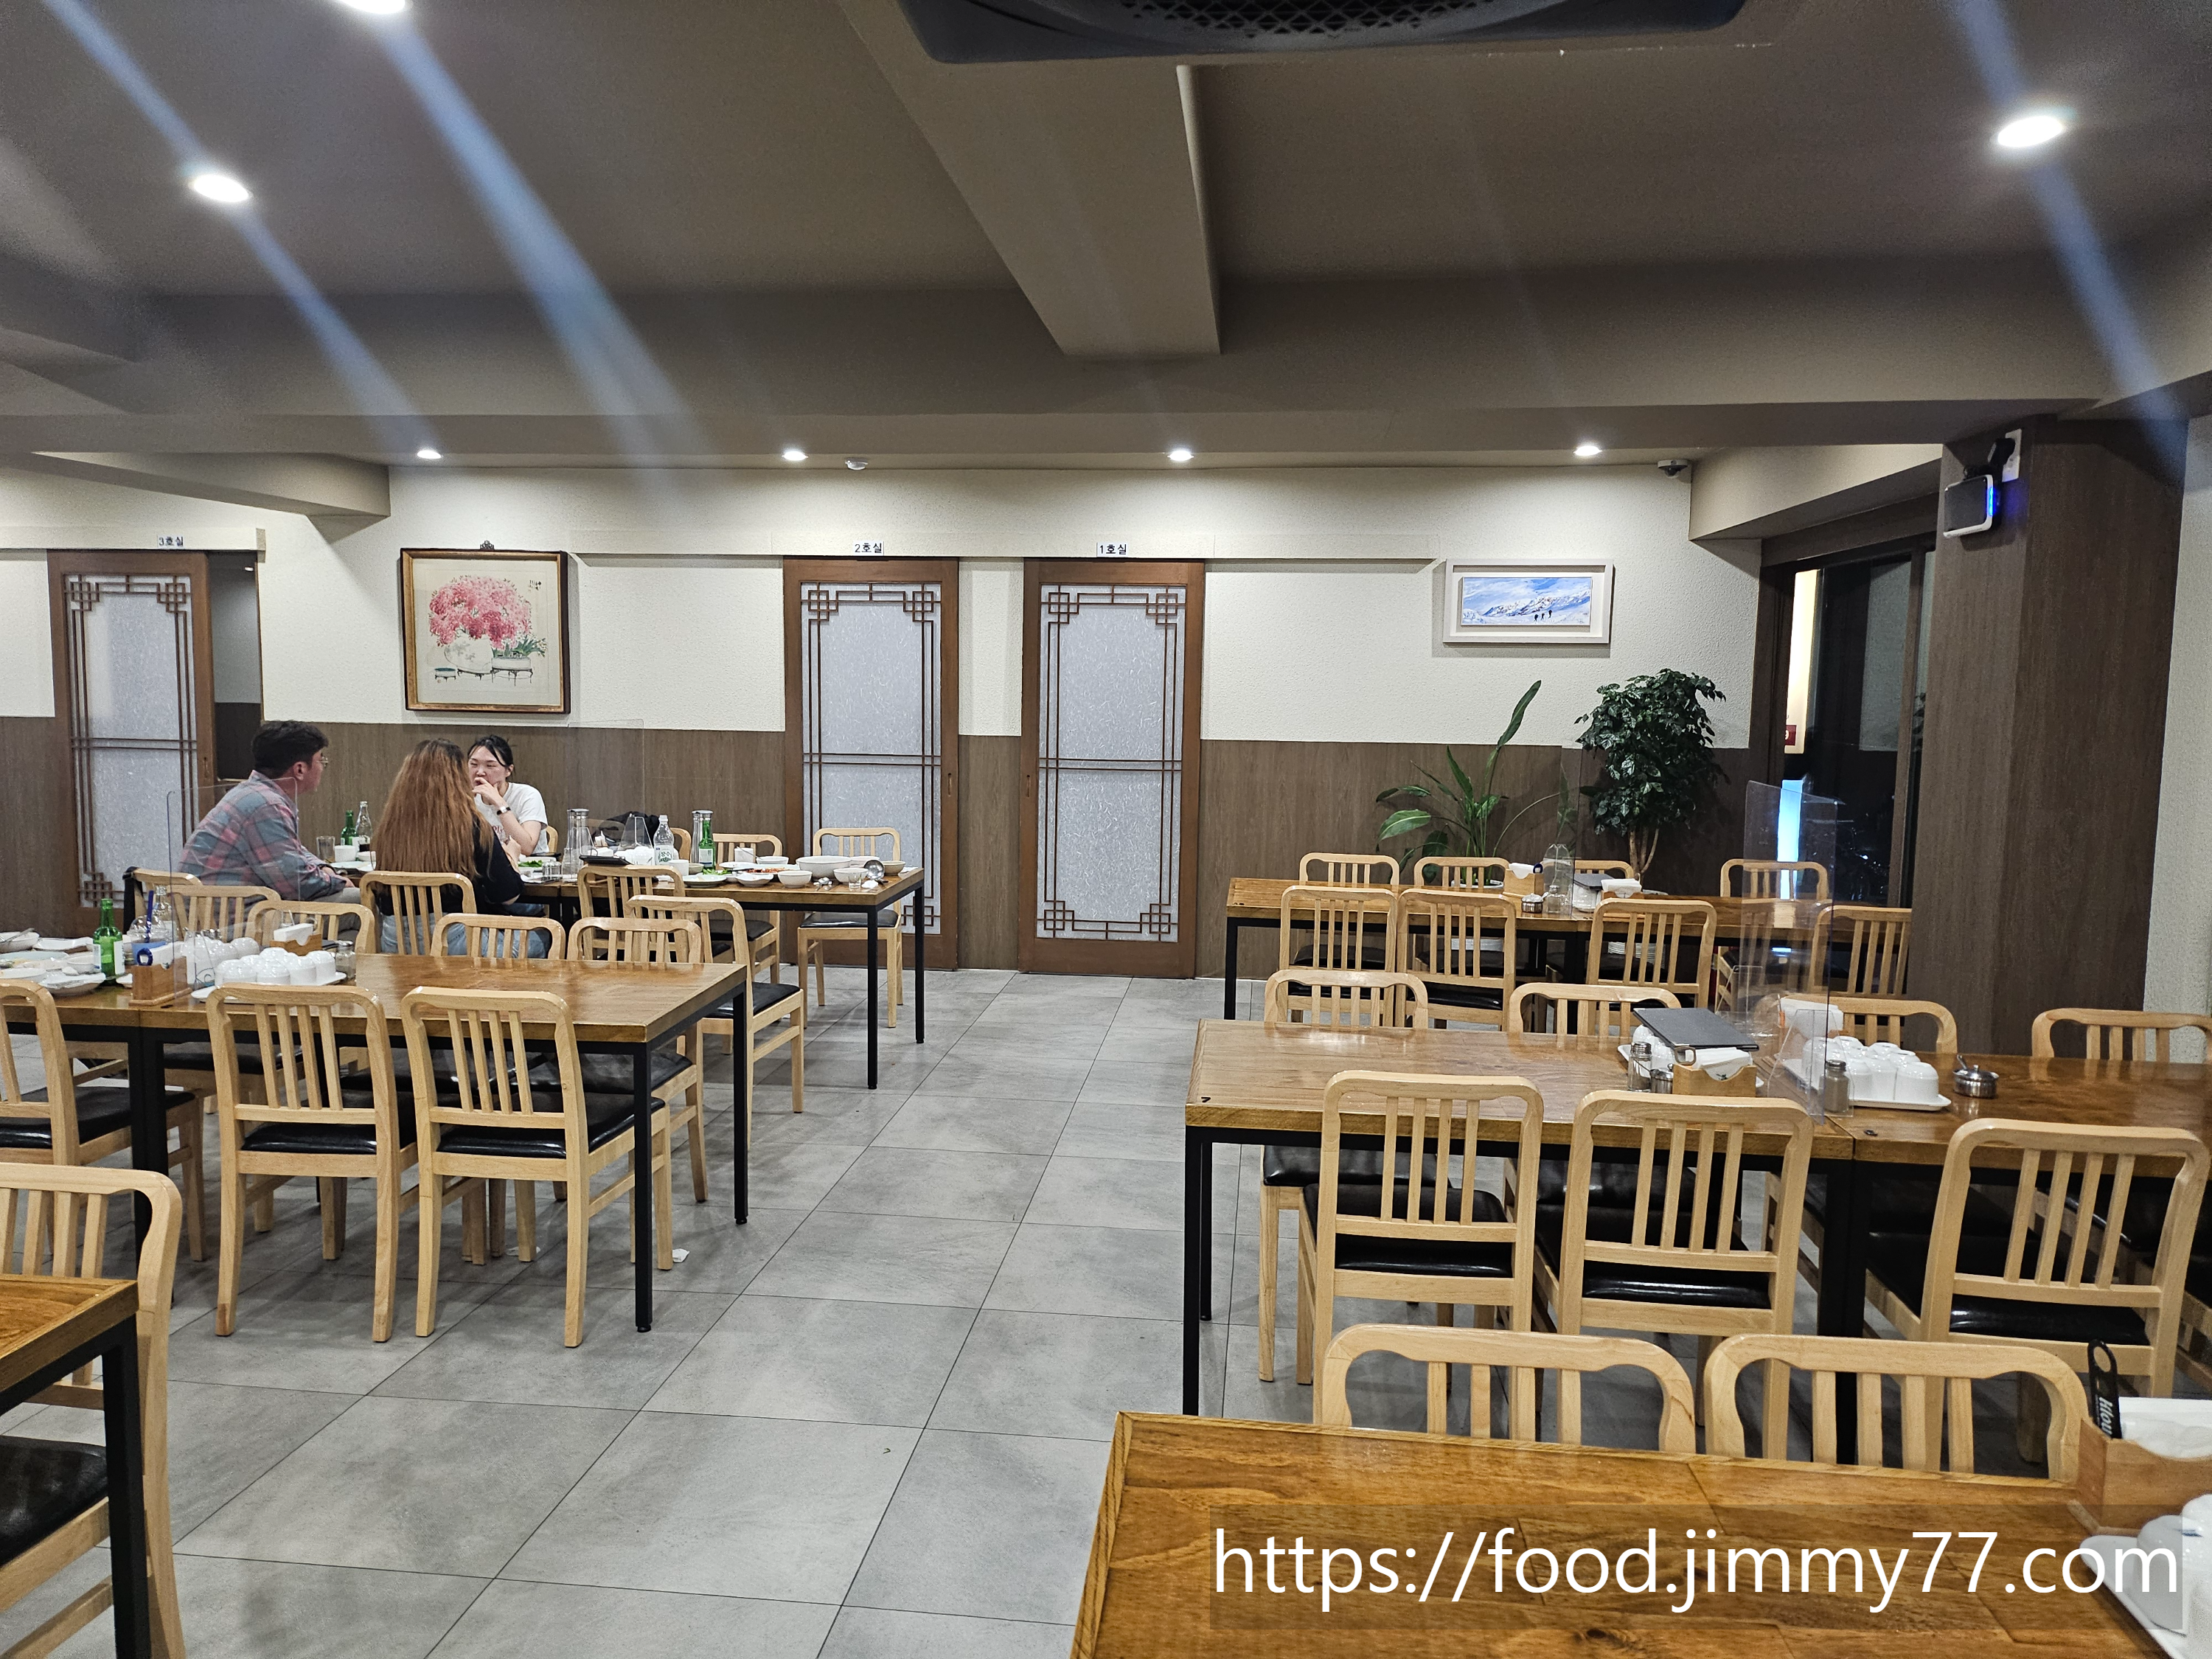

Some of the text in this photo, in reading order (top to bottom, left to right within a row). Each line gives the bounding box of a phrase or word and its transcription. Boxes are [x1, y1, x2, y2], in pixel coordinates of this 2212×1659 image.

[159, 536, 184, 546] 3호실
[855, 543, 882, 554] 2호실
[1099, 543, 1127, 554] 1호실
